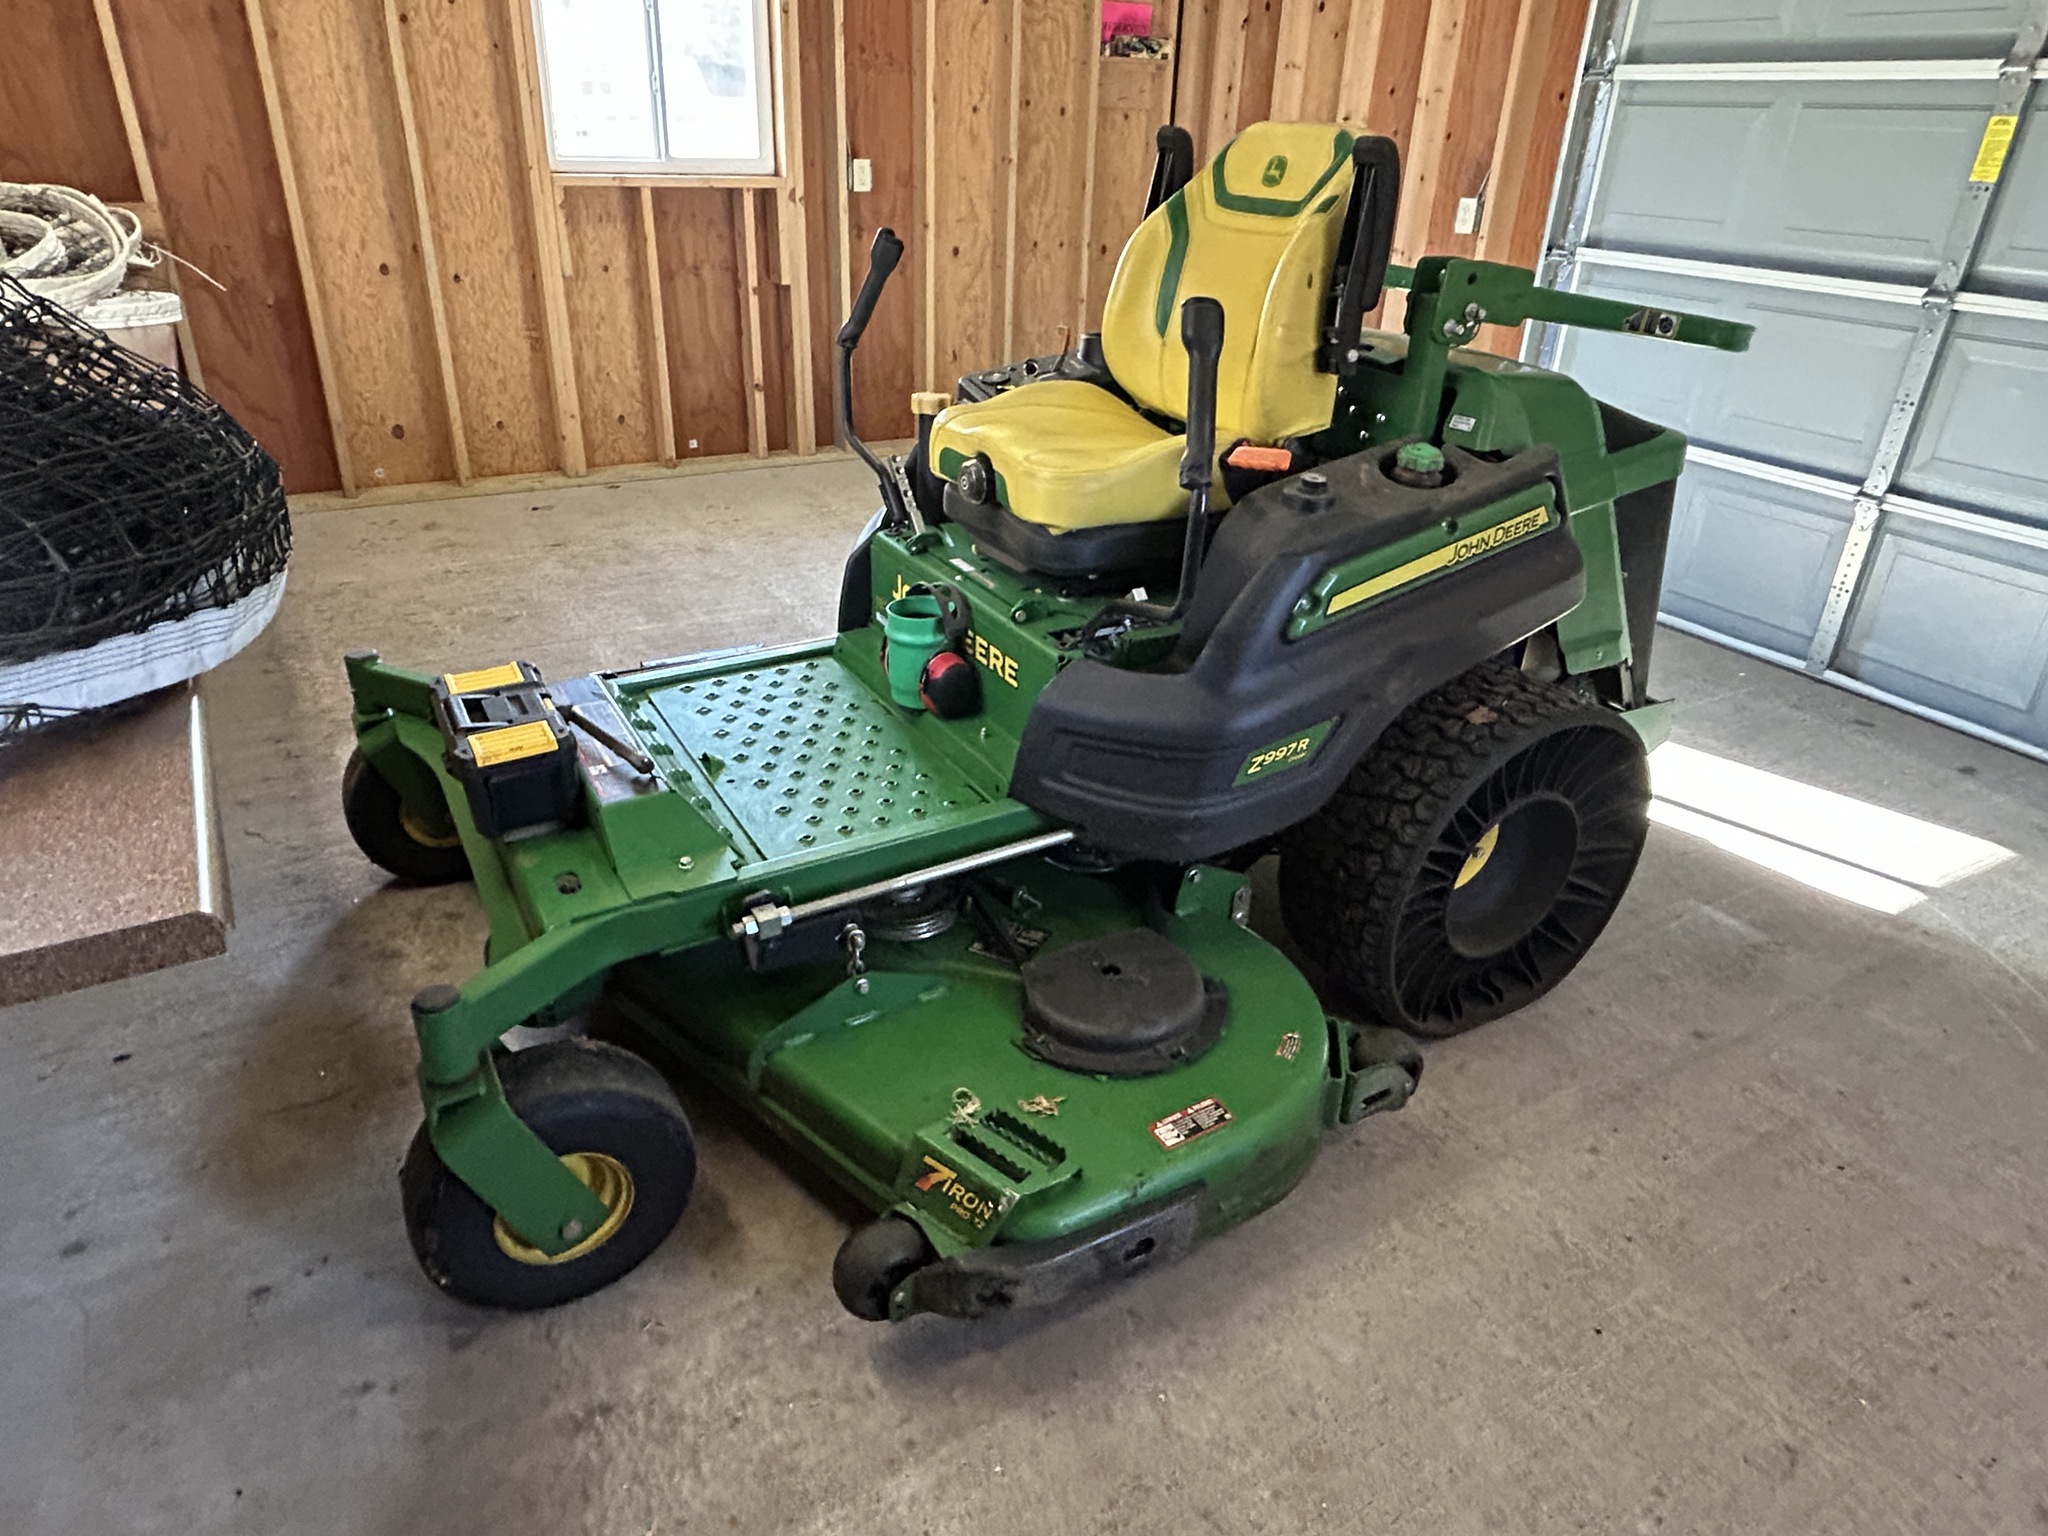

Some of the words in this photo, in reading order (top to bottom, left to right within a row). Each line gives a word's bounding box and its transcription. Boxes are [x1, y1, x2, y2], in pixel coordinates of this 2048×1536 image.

[1447, 534, 1491, 564] JOHN
[1492, 513, 1541, 544] DEERE
[1247, 737, 1310, 775] Z997R
